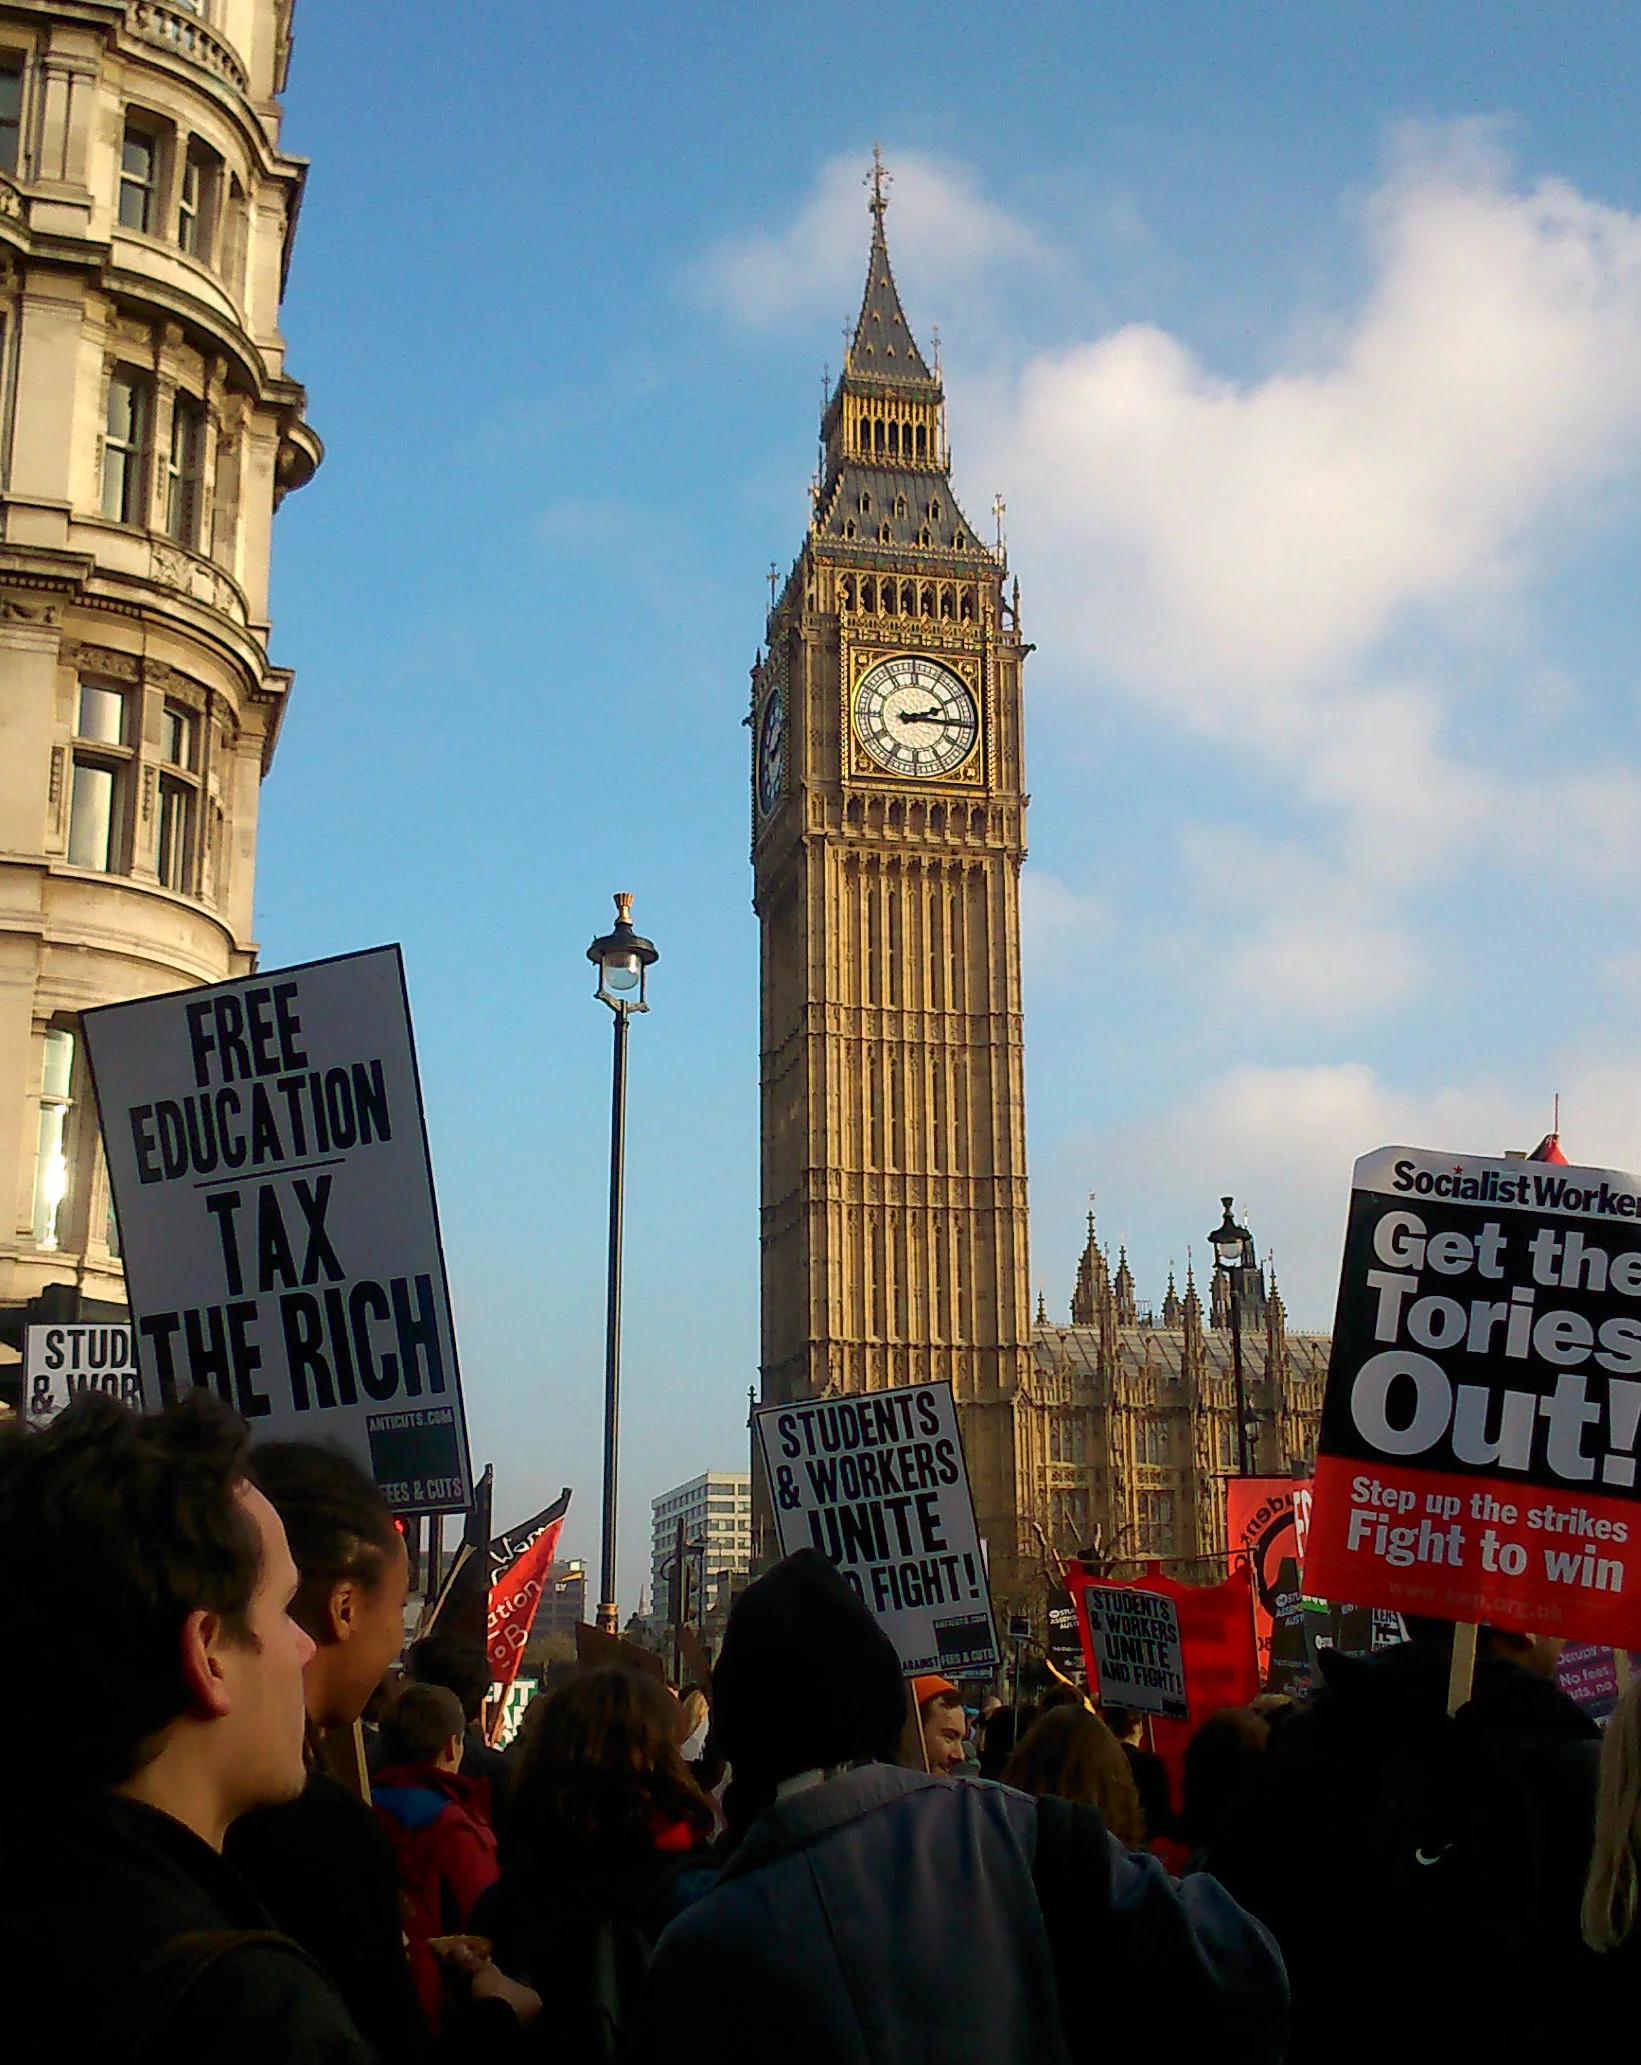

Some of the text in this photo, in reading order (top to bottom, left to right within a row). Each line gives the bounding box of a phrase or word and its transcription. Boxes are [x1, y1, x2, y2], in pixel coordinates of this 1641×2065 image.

[186, 983, 309, 1088] FREE
[128, 1059, 392, 1185] EDUCATION
[1392, 1160, 1531, 1205] Socialist
[206, 1175, 345, 1296] TAX
[1372, 1210, 1641, 1298] Get the
[140, 1274, 445, 1420] THE RICH
[1366, 1269, 1641, 1374] Tories
[31, 1374, 54, 1415] &
[777, 1390, 939, 1459] STUDENTS
[1351, 1349, 1640, 1488] Out!
[413, 1480, 424, 1500] &
[427, 1477, 463, 1499] CUTS
[777, 1439, 959, 1510] & WORKERS
[808, 1493, 948, 1566] UNITE
[1350, 1476, 1629, 1544] Step up the strikes
[870, 1553, 980, 1612] FIGHT!
[1347, 1508, 1465, 1567] Fight
[1479, 1529, 1527, 1576] to
[1544, 1544, 1625, 1593] win
[1092, 1589, 1170, 1621] STUDENTS
[1105, 1613, 1178, 1644] WORKERS
[902, 1656, 938, 1671] AGAINST
[1102, 1660, 1131, 1683] AND
[1104, 1633, 1171, 1670] UNITE
[1560, 1666, 1609, 1687] No fees
[1596, 1681, 1613, 1693] no
